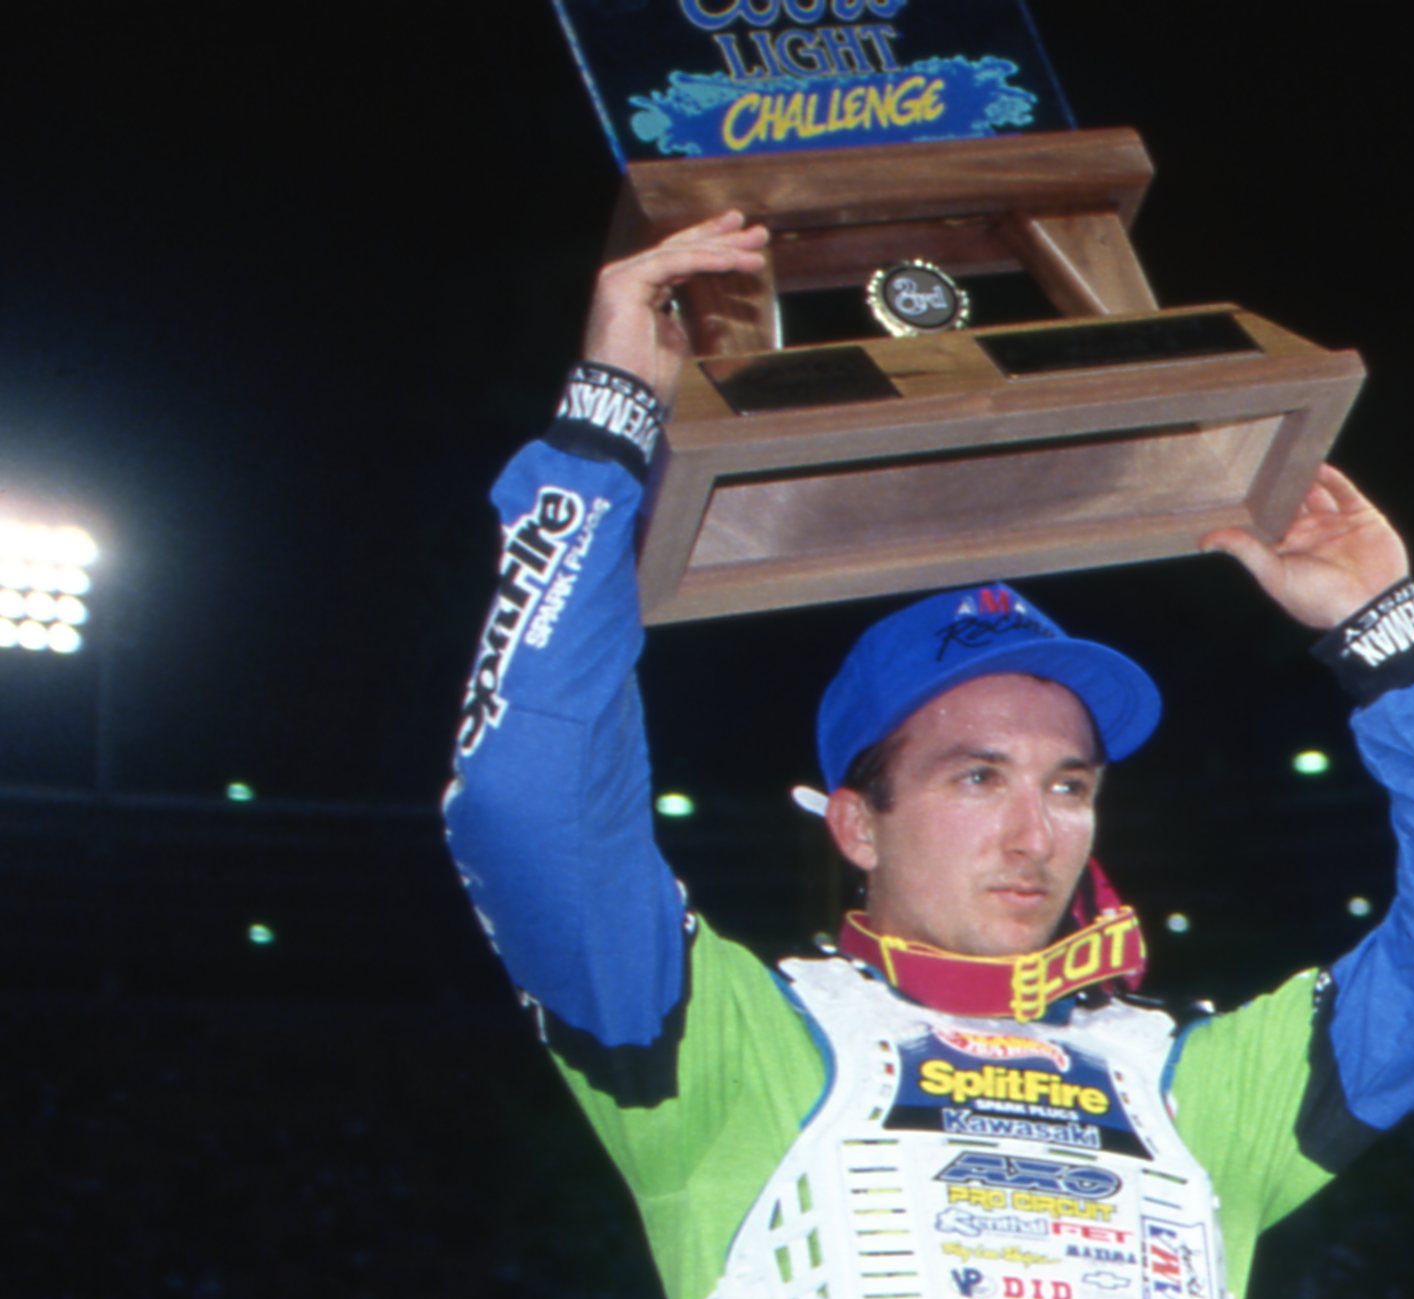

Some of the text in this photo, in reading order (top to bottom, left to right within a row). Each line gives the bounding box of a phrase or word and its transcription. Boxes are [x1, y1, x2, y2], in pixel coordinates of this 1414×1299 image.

[713, 24, 901, 82] LIGHT
[722, 76, 945, 150] CHALLENGE
[564, 496, 611, 572] PLUGS
[525, 573, 580, 650] SPARK
[919, 1059, 1110, 1115] SplitFire
[941, 1107, 1102, 1150] Kawasaki
[932, 1150, 1124, 1200] AXO
[947, 1185, 1119, 1224] PRO CIRCUIT
